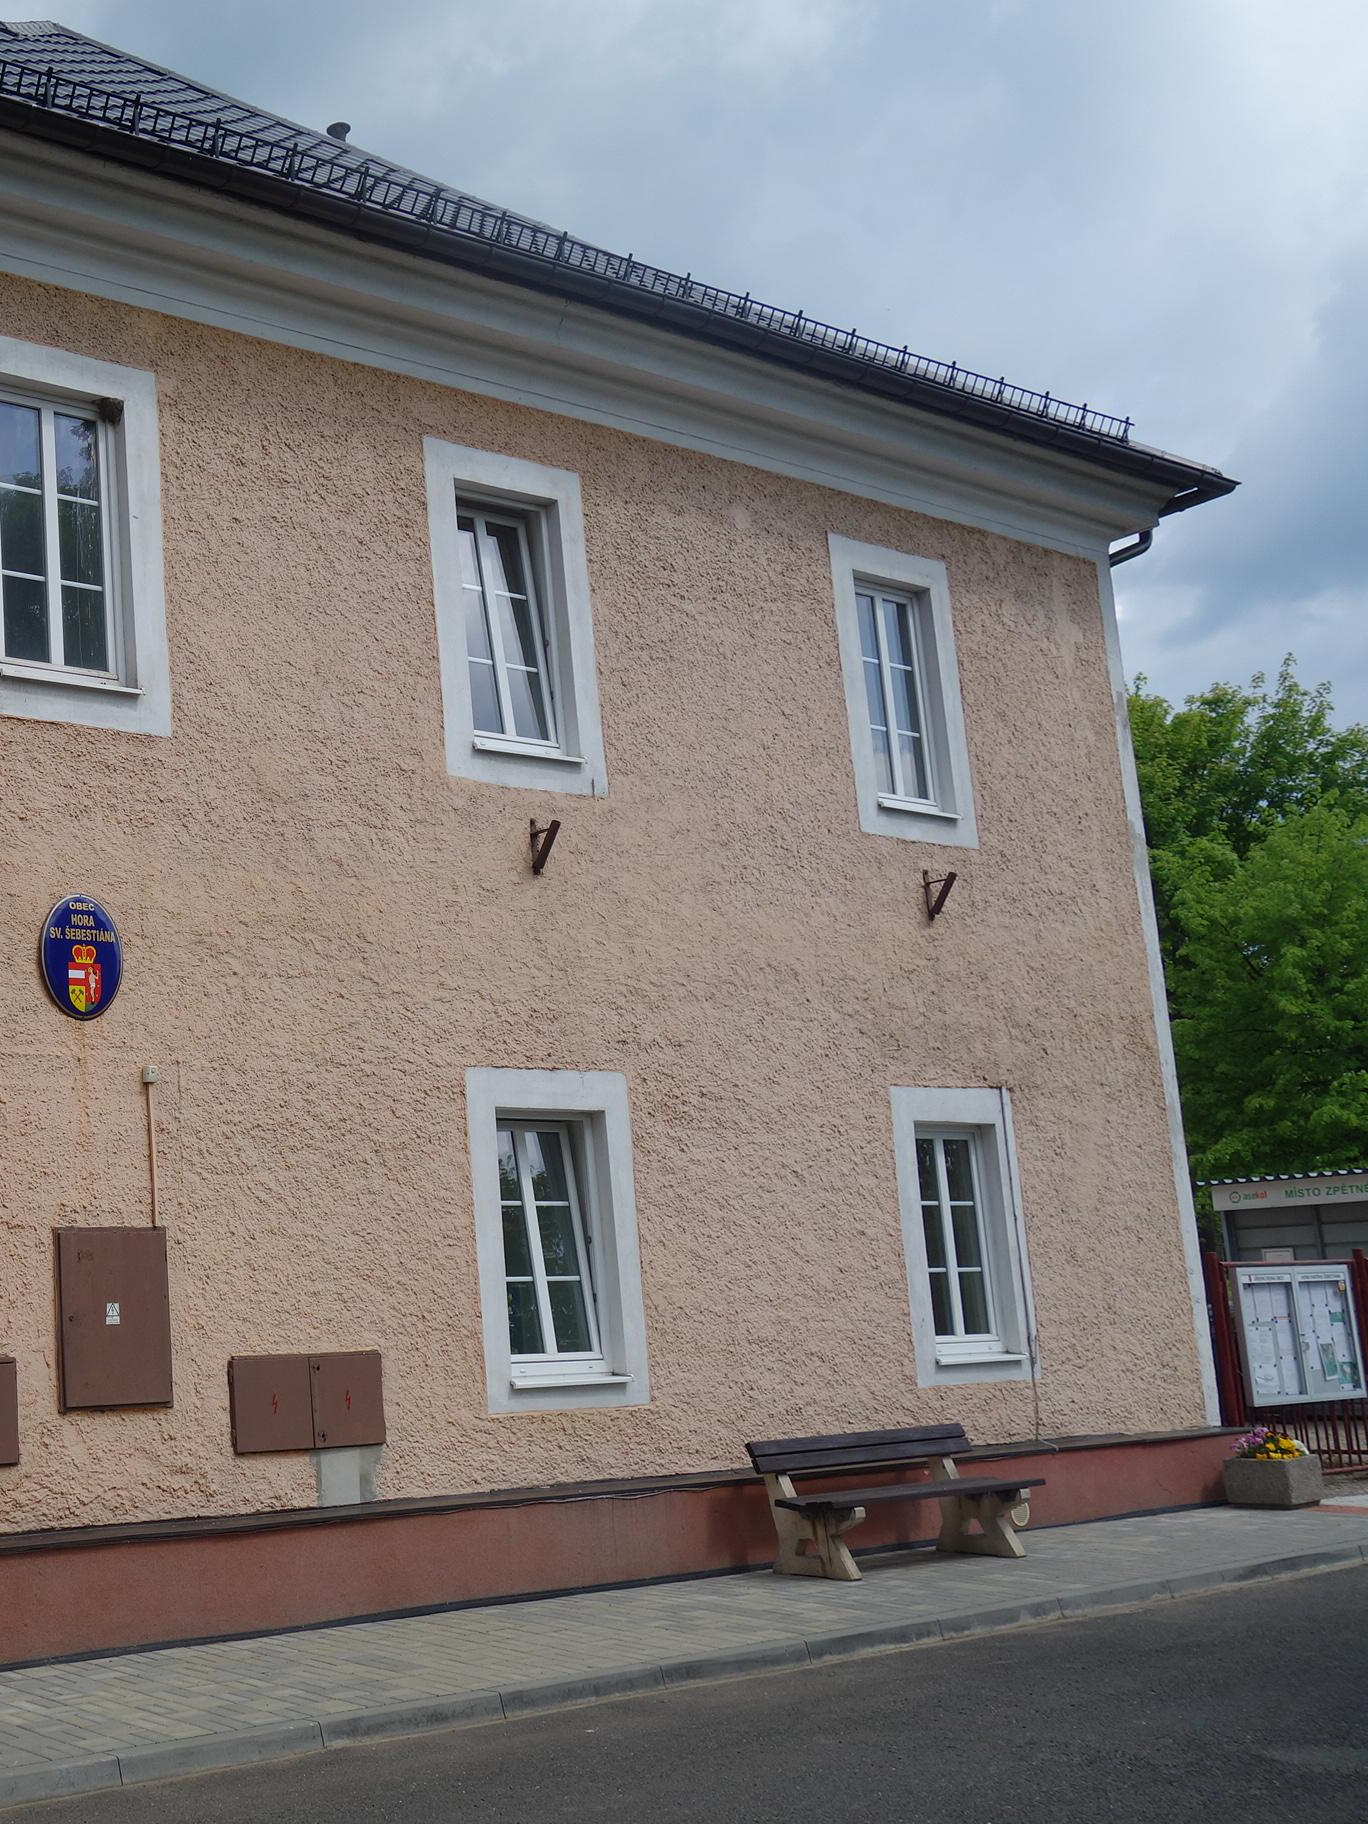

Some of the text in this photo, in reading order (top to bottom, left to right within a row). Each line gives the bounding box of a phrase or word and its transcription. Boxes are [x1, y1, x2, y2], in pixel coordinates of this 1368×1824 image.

[69, 902, 95, 911] OBEC
[71, 914, 95, 927] HORA
[49, 925, 116, 943] SV. ŠEBESTIÁNA
